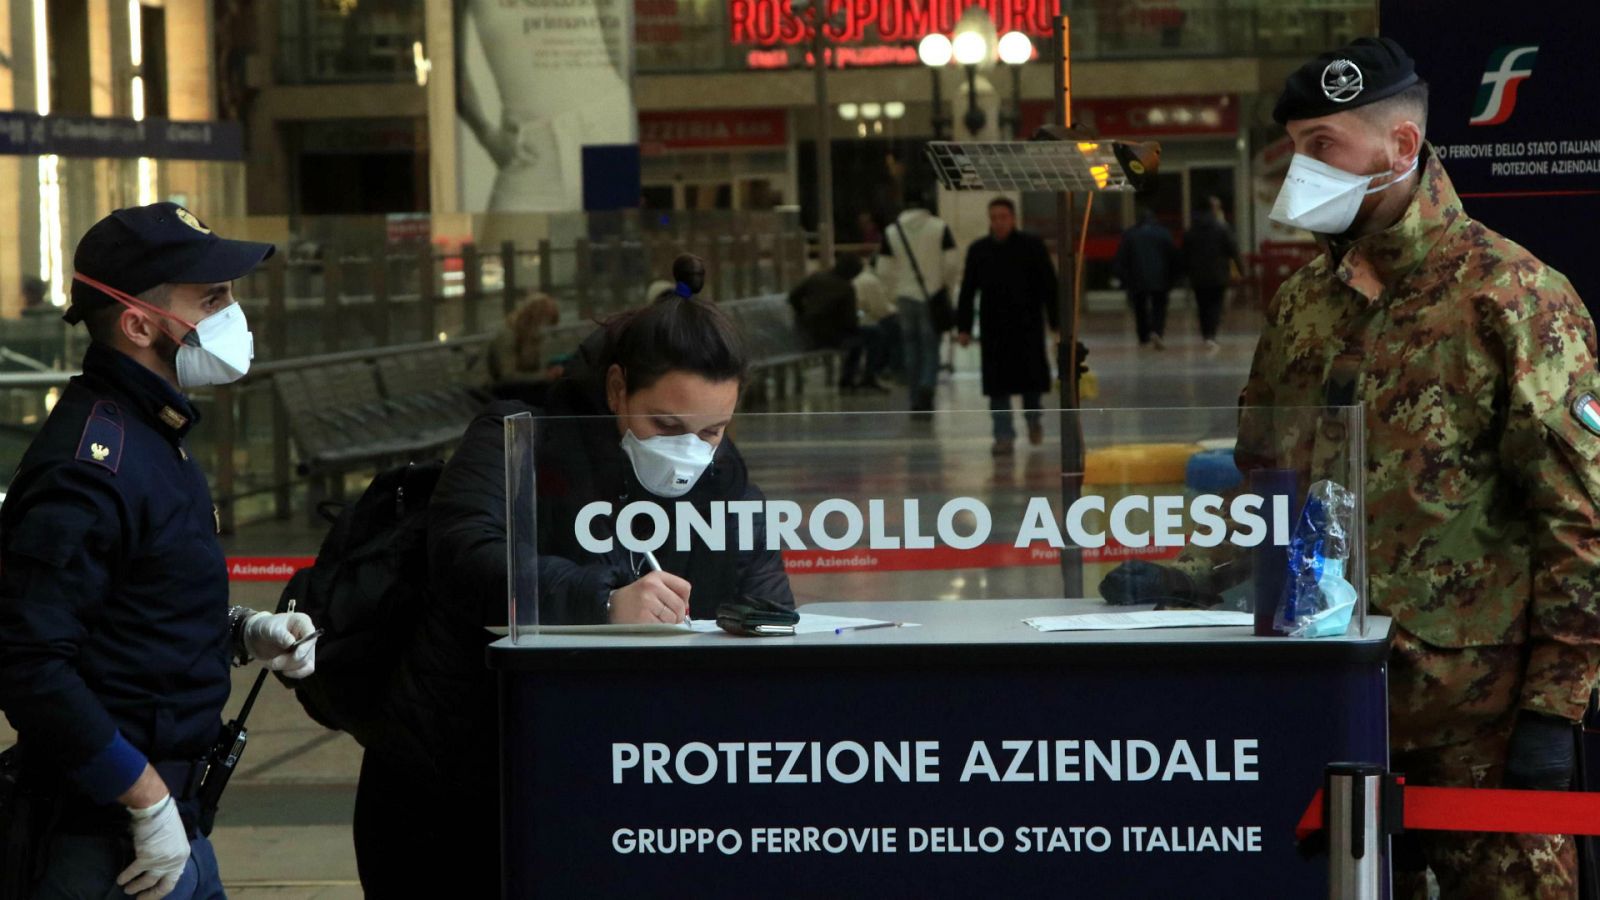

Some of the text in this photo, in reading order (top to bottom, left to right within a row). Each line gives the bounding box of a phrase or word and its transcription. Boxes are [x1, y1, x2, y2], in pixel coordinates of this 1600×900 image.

[731, 0, 1061, 45] ROSOPOMOORO
[1449, 144, 1493, 158] FERROVIE
[1495, 142, 1525, 156] DELLO
[1527, 141, 1557, 155] STATO
[1492, 161, 1548, 176] PROTEZIONE
[575, 493, 1291, 555] CONTROLLO ACCESSI
[232, 563, 295, 575] Aziendale
[815, 555, 879, 567] Aziendale
[612, 738, 1260, 785] PROTEZIONE AZIENDALE
[611, 825, 1263, 855] GRUPPO FERROVIE DELLO STATO ITALIANE
